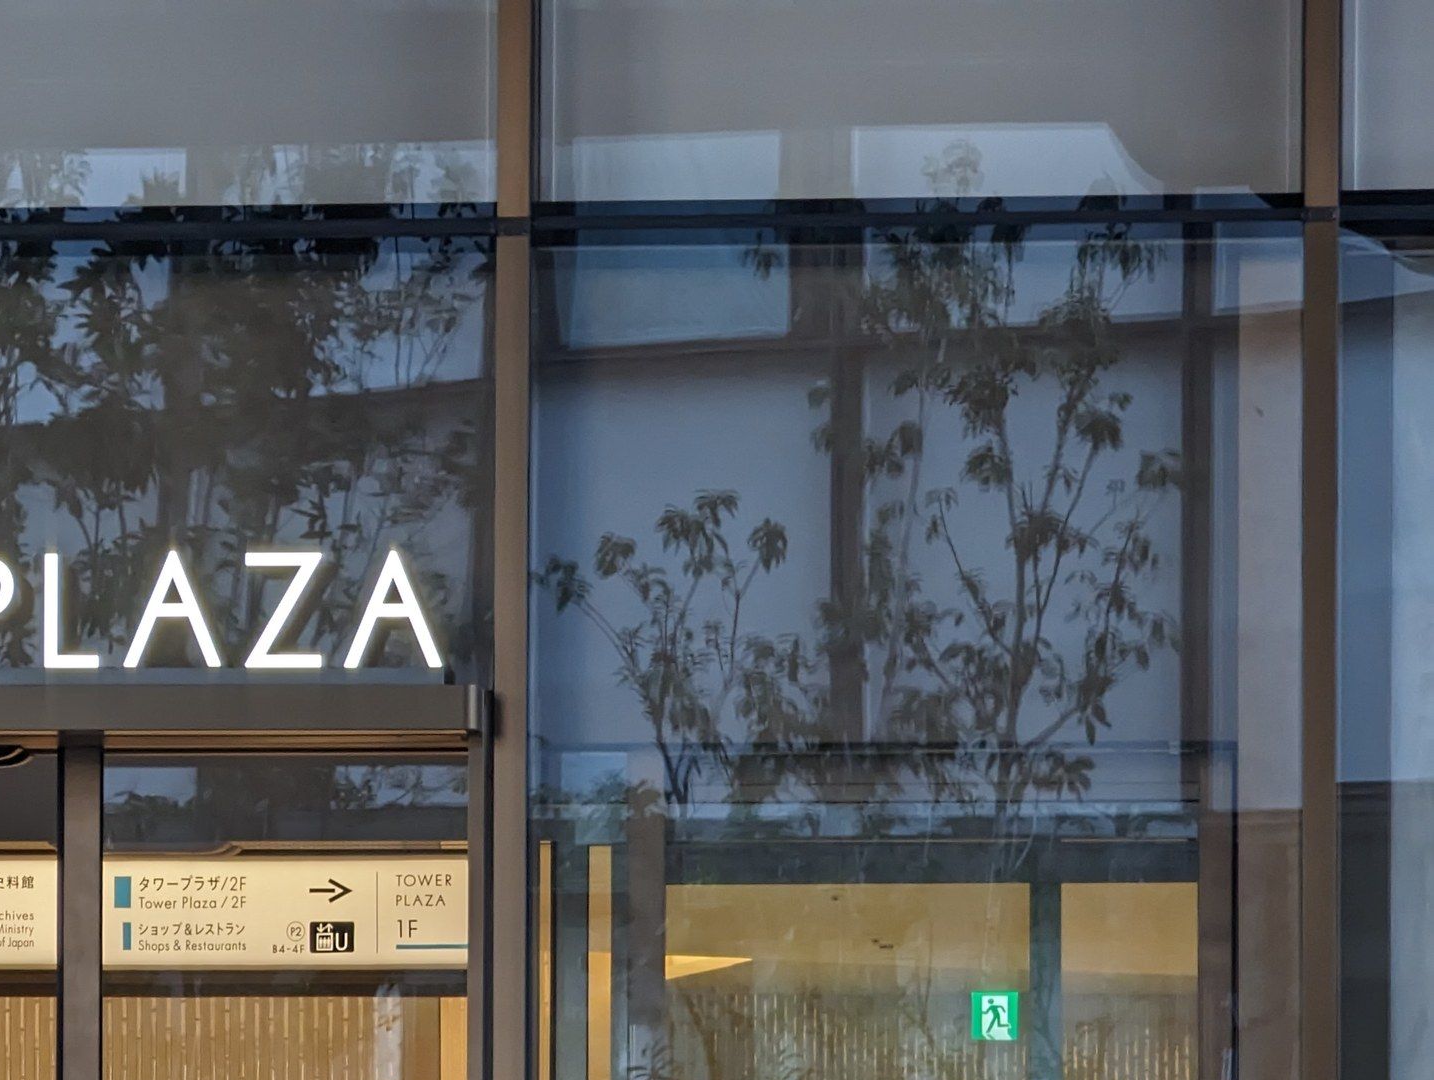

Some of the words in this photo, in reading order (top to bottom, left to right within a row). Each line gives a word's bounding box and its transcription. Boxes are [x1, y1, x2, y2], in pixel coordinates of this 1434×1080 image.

[395, 874, 452, 887] TOWER
[138, 896, 177, 909] Tower
[181, 896, 217, 909] Plaza
[231, 896, 246, 909] 2F
[395, 894, 446, 907] PLAZA
[138, 922, 245, 936] ショップ&レストラン
[290, 926, 302, 937] P2
[397, 919, 418, 938] 1F
[8, 938, 34, 950] Japan
[138, 940, 170, 954] Shops
[173, 939, 181, 951] &
[185, 940, 247, 951] Restaurants
[272, 944, 305, 954] B4-4F
